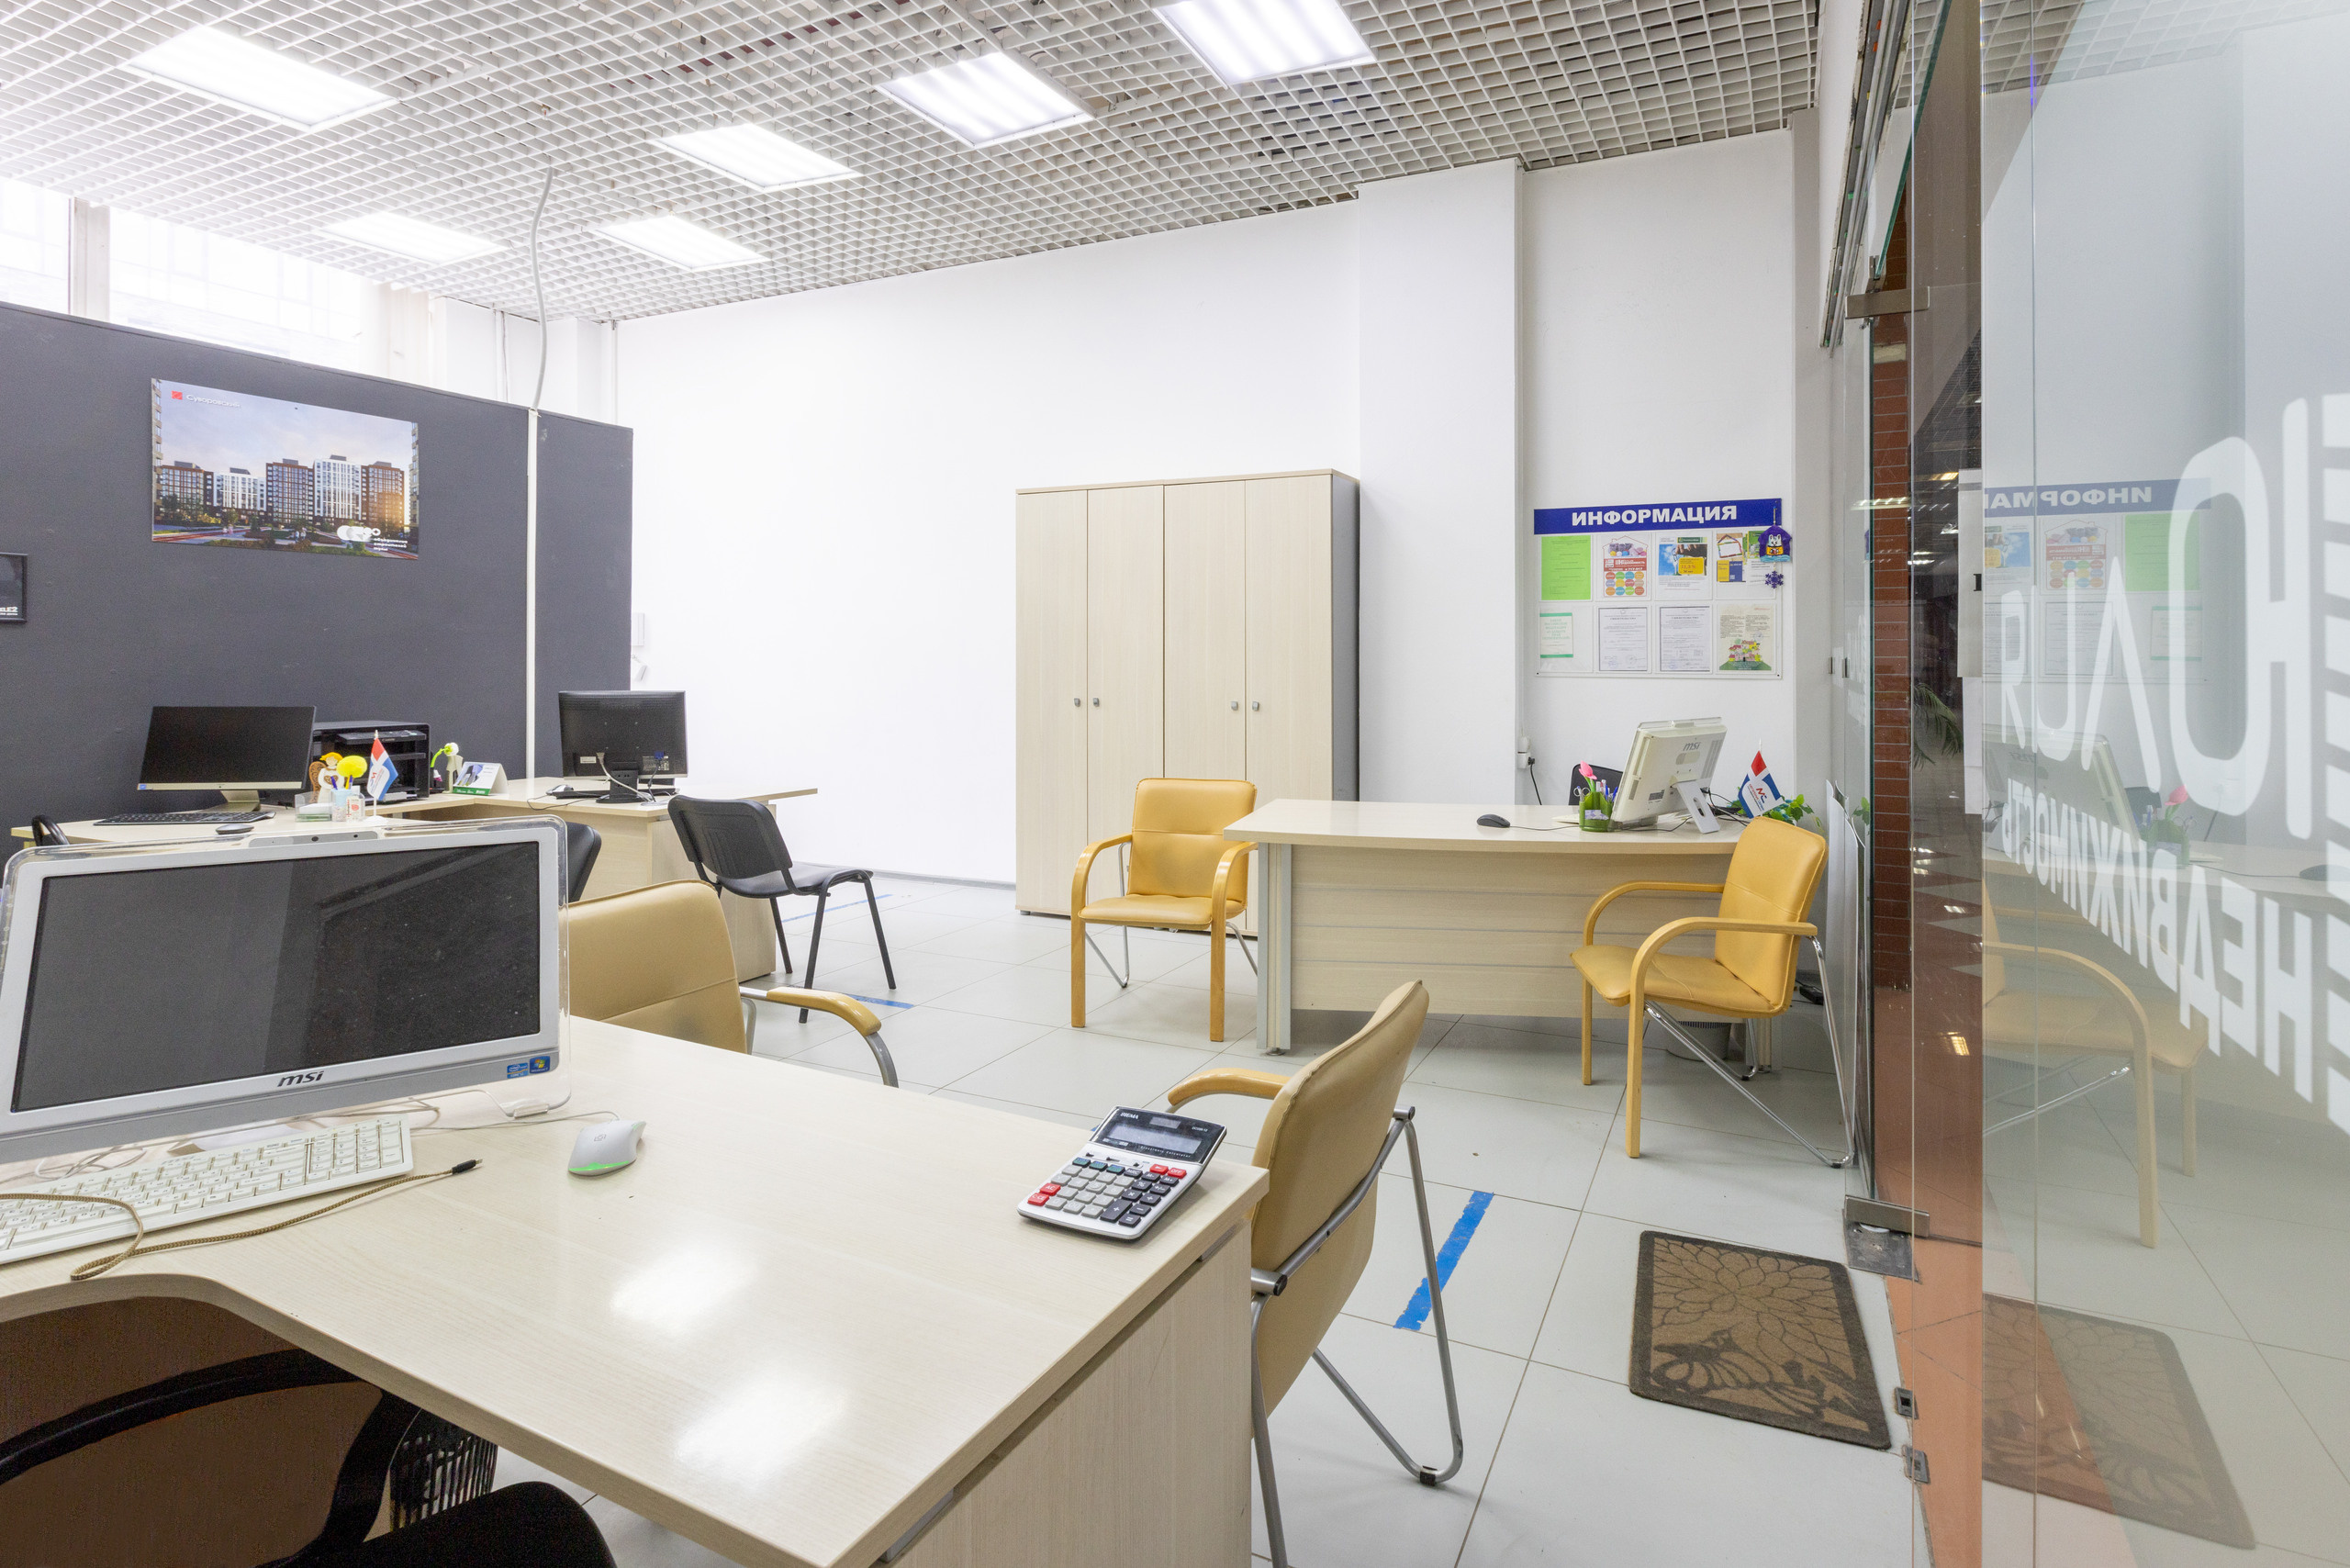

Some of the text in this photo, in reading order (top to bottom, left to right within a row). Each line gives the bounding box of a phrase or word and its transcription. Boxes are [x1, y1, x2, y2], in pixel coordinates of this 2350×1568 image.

[1572, 505, 1738, 526] ИНФОРМАЦИЯ
[1683, 742, 1702, 751] msi
[277, 1070, 324, 1088] msi
